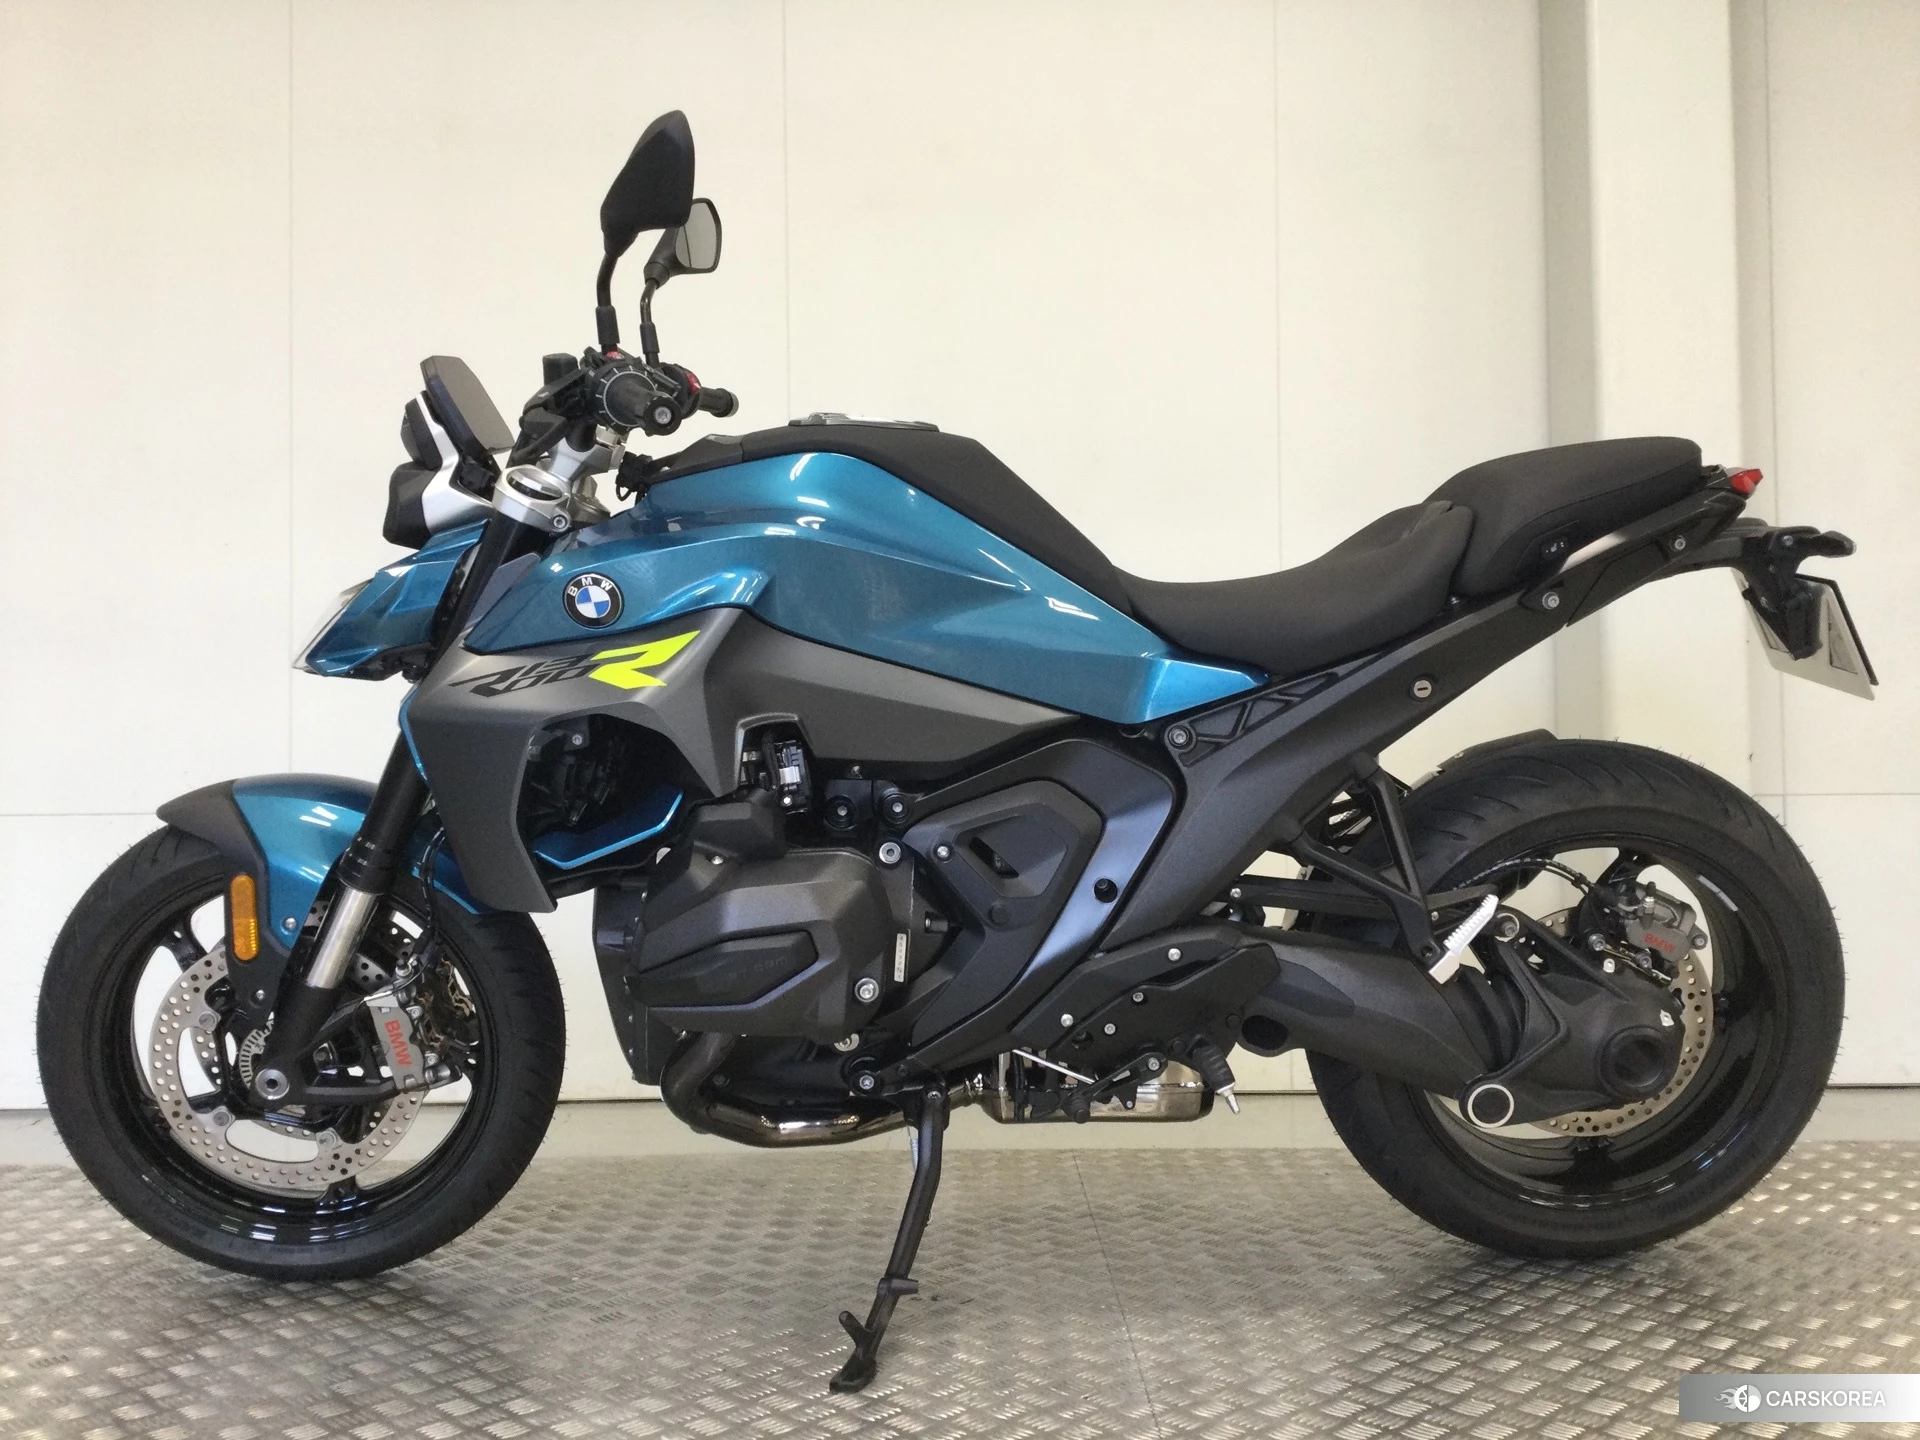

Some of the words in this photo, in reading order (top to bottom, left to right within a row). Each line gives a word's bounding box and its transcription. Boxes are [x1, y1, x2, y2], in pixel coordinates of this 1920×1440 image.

[567, 576, 613, 597] BMW
[1643, 932, 1677, 952] BMW
[384, 1019, 413, 1066] BMW
